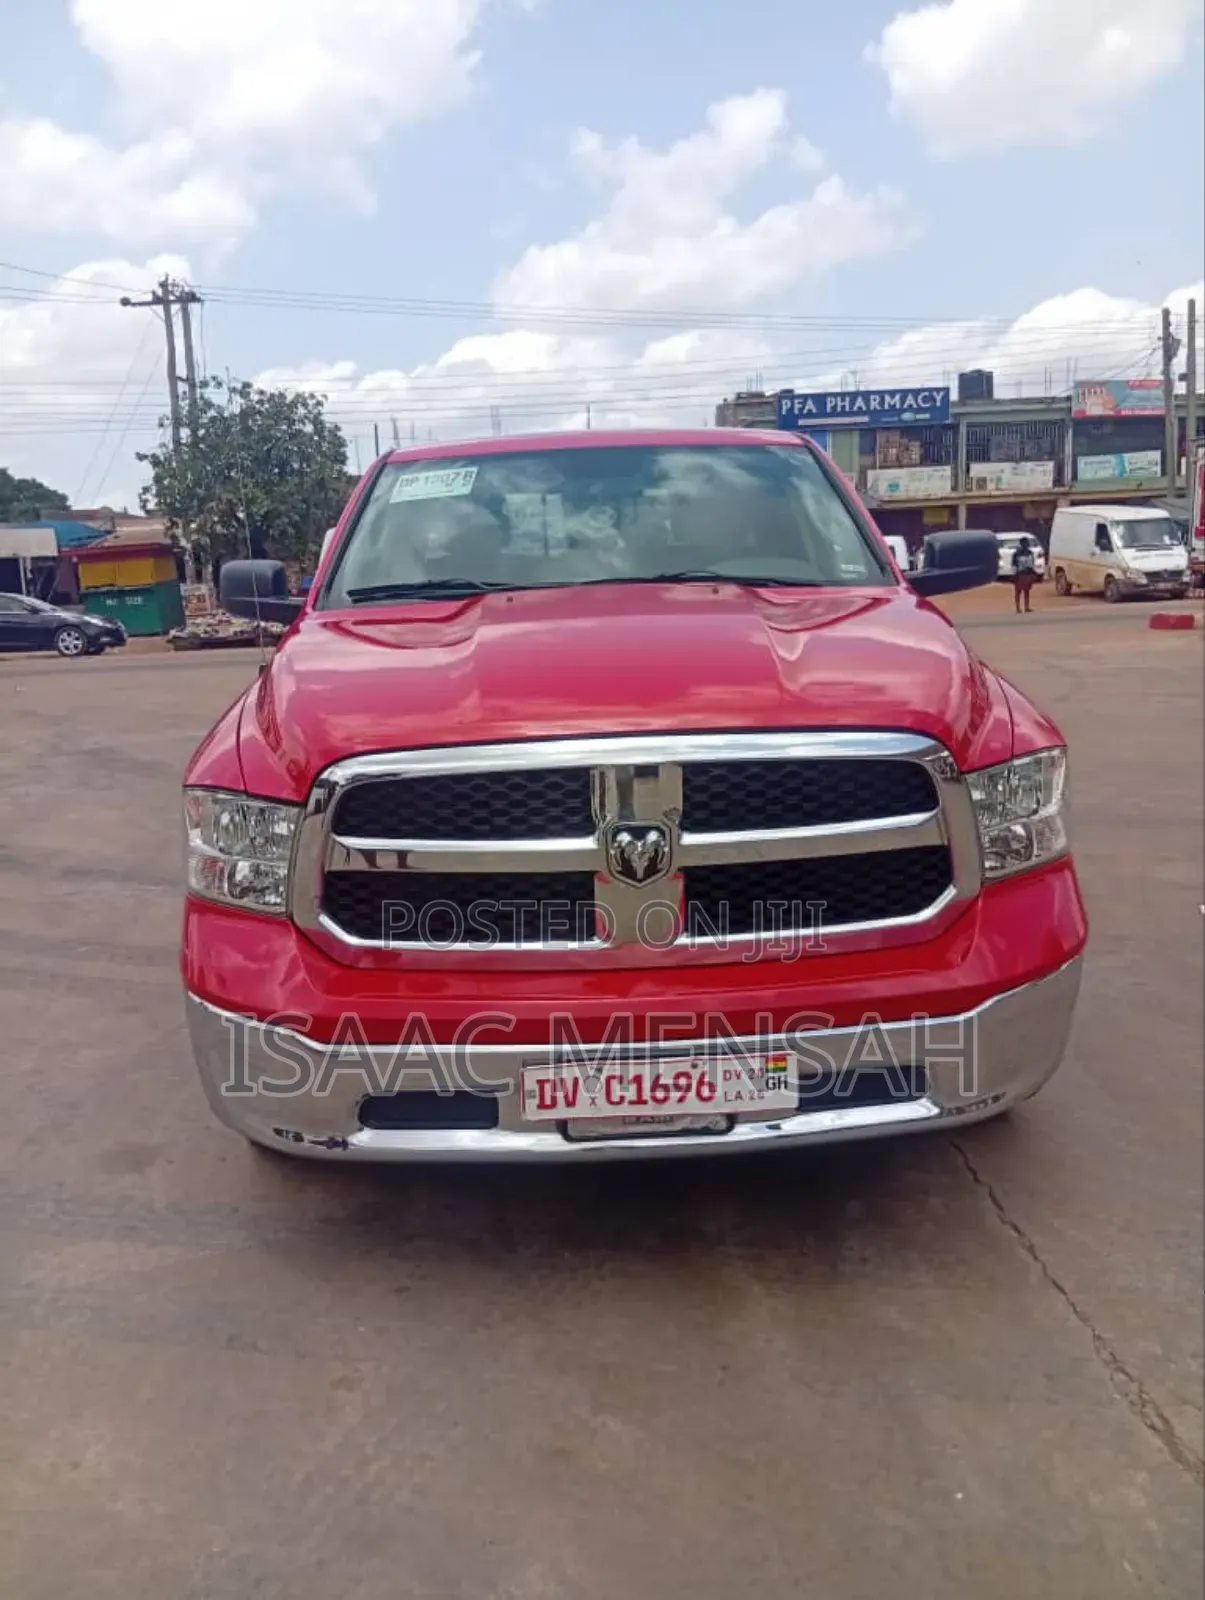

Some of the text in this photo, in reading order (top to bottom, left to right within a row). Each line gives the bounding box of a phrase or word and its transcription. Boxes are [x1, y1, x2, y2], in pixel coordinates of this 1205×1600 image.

[781, 391, 947, 415] PFA PHARMACY
[723, 1069, 743, 1081] DV
[766, 1074, 788, 1090] GH
[536, 1070, 717, 1110] DV C1696
